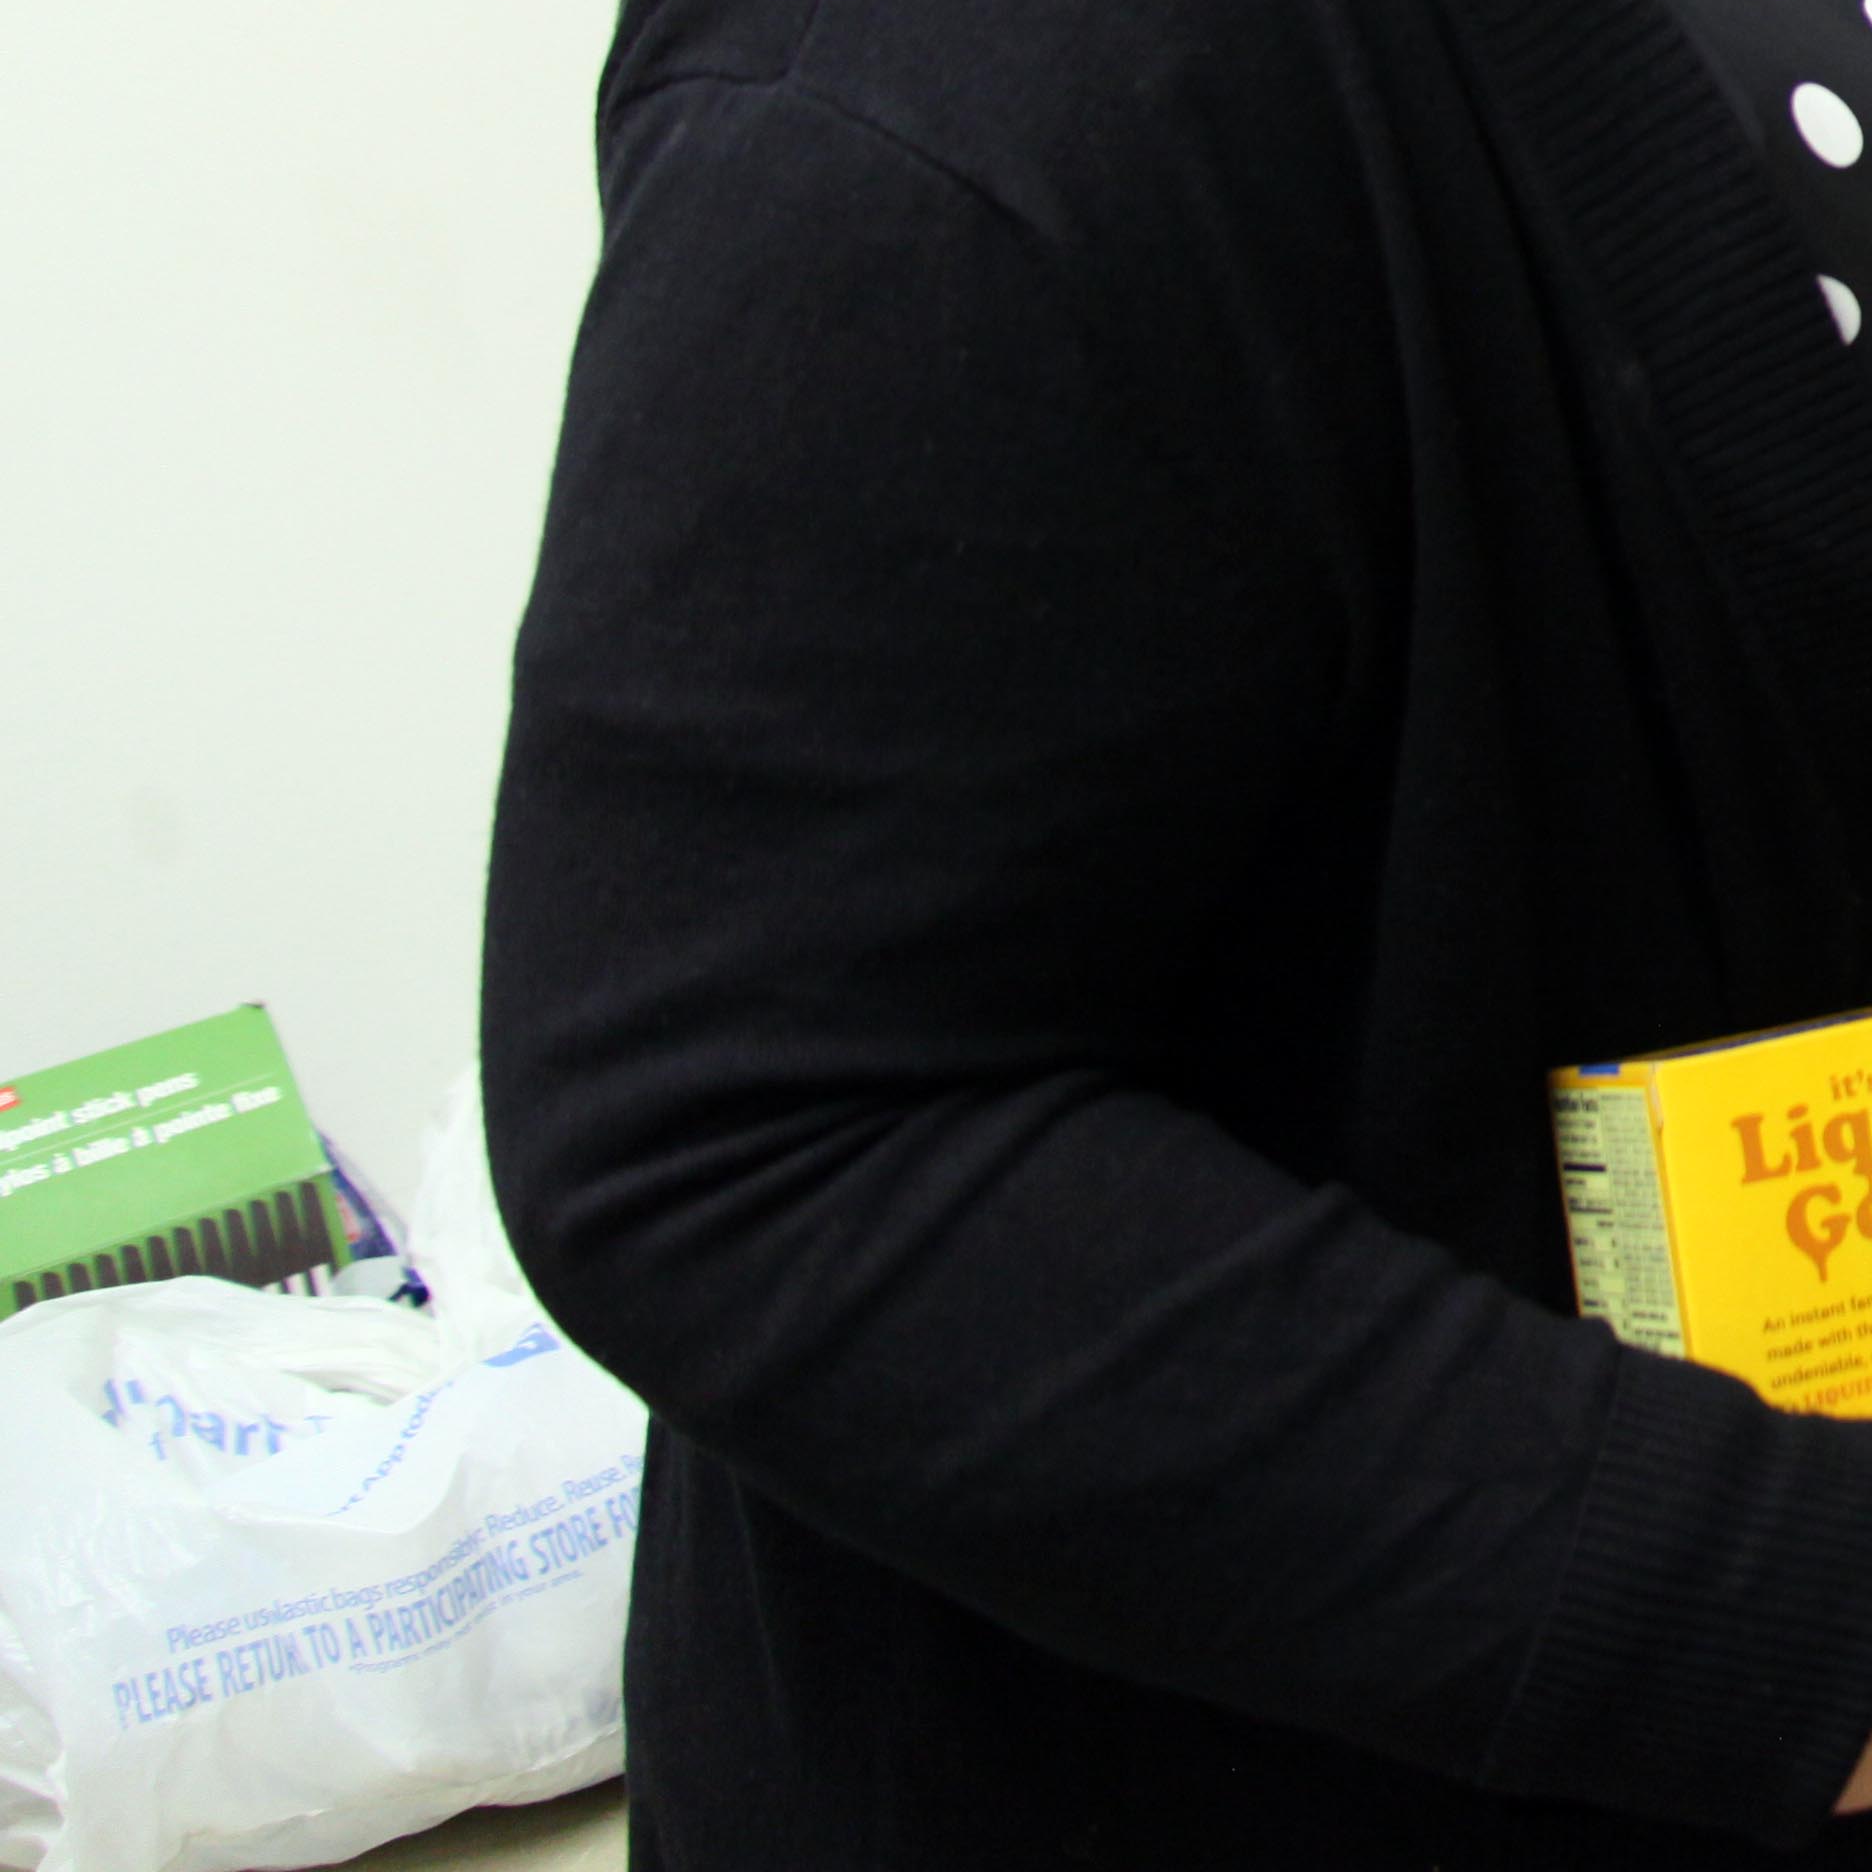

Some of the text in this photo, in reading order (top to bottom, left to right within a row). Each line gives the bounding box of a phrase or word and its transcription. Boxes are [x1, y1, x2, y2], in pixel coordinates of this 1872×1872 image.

[70, 1071, 201, 1125] stick pens
[52, 1152, 73, 1175] à
[72, 1137, 131, 1168] bille
[131, 1125, 151, 1149] à
[152, 1102, 233, 1145] pointe
[230, 1086, 283, 1114] fixe
[1762, 1316, 1786, 1335] An
[1790, 1298, 1847, 1327] instant
[1766, 1339, 1814, 1362] made
[1817, 1328, 1853, 1350] with
[1769, 1354, 1869, 1390] undeniable,
[166, 1616, 242, 1654] Please
[331, 1584, 384, 1612] bags
[485, 1494, 566, 1539] Reduce.
[561, 1466, 627, 1503] Reuse.
[112, 1657, 214, 1730] PLEASE
[302, 1622, 342, 1670] TO
[345, 1617, 367, 1659] A
[366, 1539, 530, 1655] PARTICIPATING
[529, 1506, 609, 1575] STORE
[604, 1487, 641, 1539] FO
